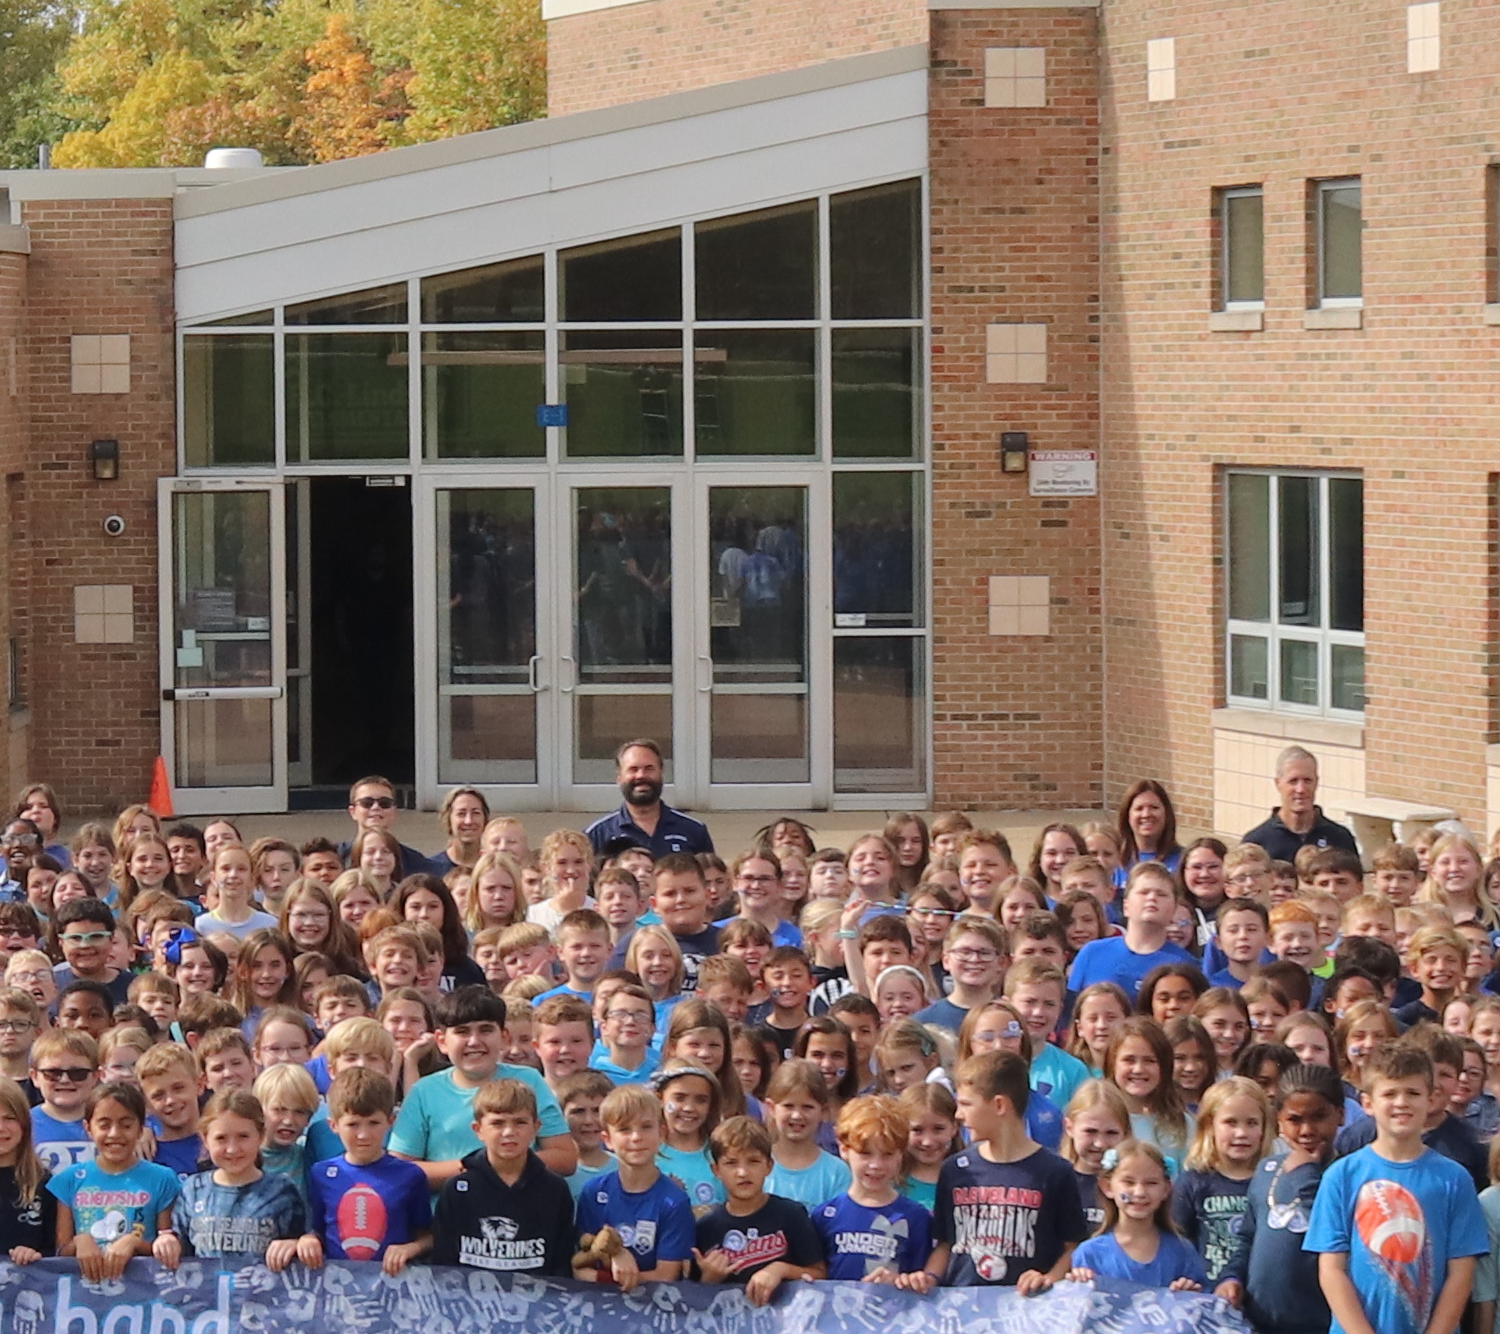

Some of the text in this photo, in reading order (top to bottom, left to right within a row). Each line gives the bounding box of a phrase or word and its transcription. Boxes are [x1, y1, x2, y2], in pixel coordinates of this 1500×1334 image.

[1034, 451, 1092, 460] WARNING
[74, 1190, 152, 1208] FRIENDSHIP
[952, 1186, 1042, 1209] CLEVELAND
[1203, 1195, 1249, 1213] CHANG
[460, 1235, 546, 1259] WOLVERINES
[834, 1232, 899, 1250] UNDER
[836, 1243, 897, 1259] ARMOUR
